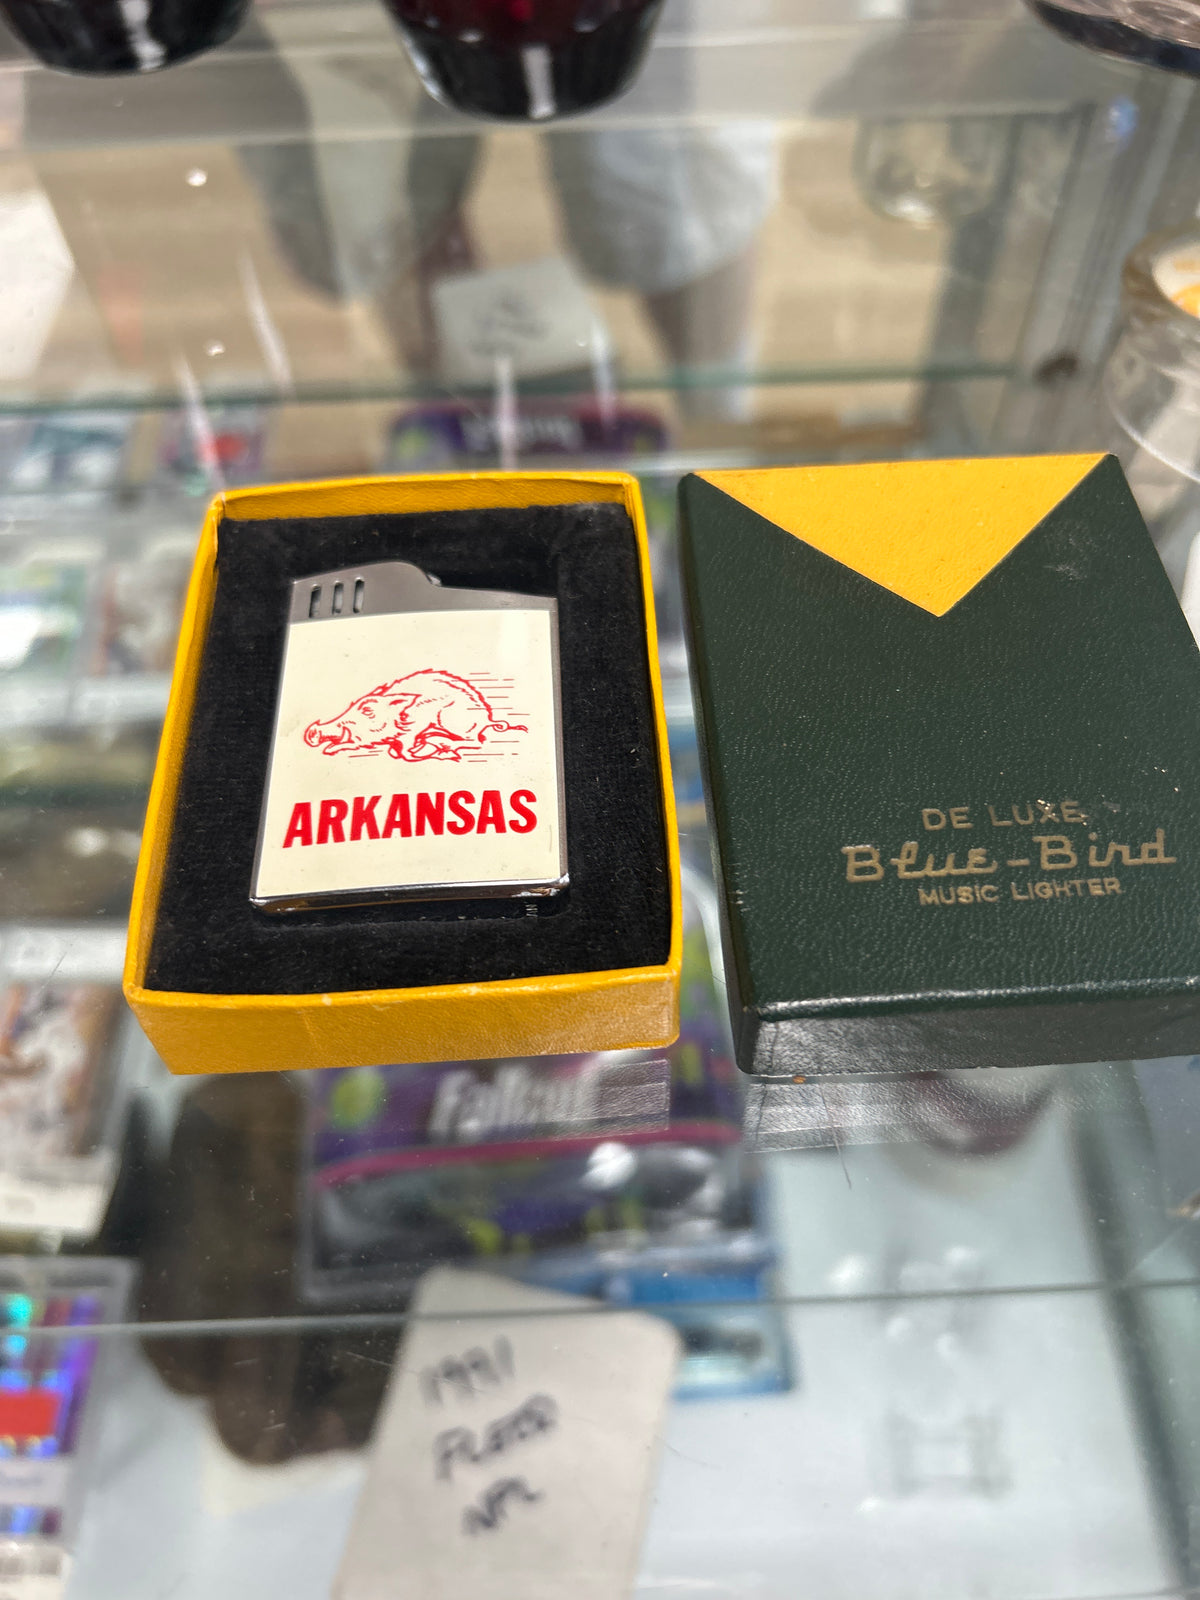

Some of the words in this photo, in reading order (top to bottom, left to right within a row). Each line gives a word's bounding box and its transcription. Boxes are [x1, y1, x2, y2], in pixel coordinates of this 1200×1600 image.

[282, 789, 537, 848] ARKANSAS
[921, 806, 973, 830] DE
[988, 801, 1083, 826] LUXE
[918, 885, 999, 905] MUSIC
[1010, 877, 1122, 900] LIGHTER
